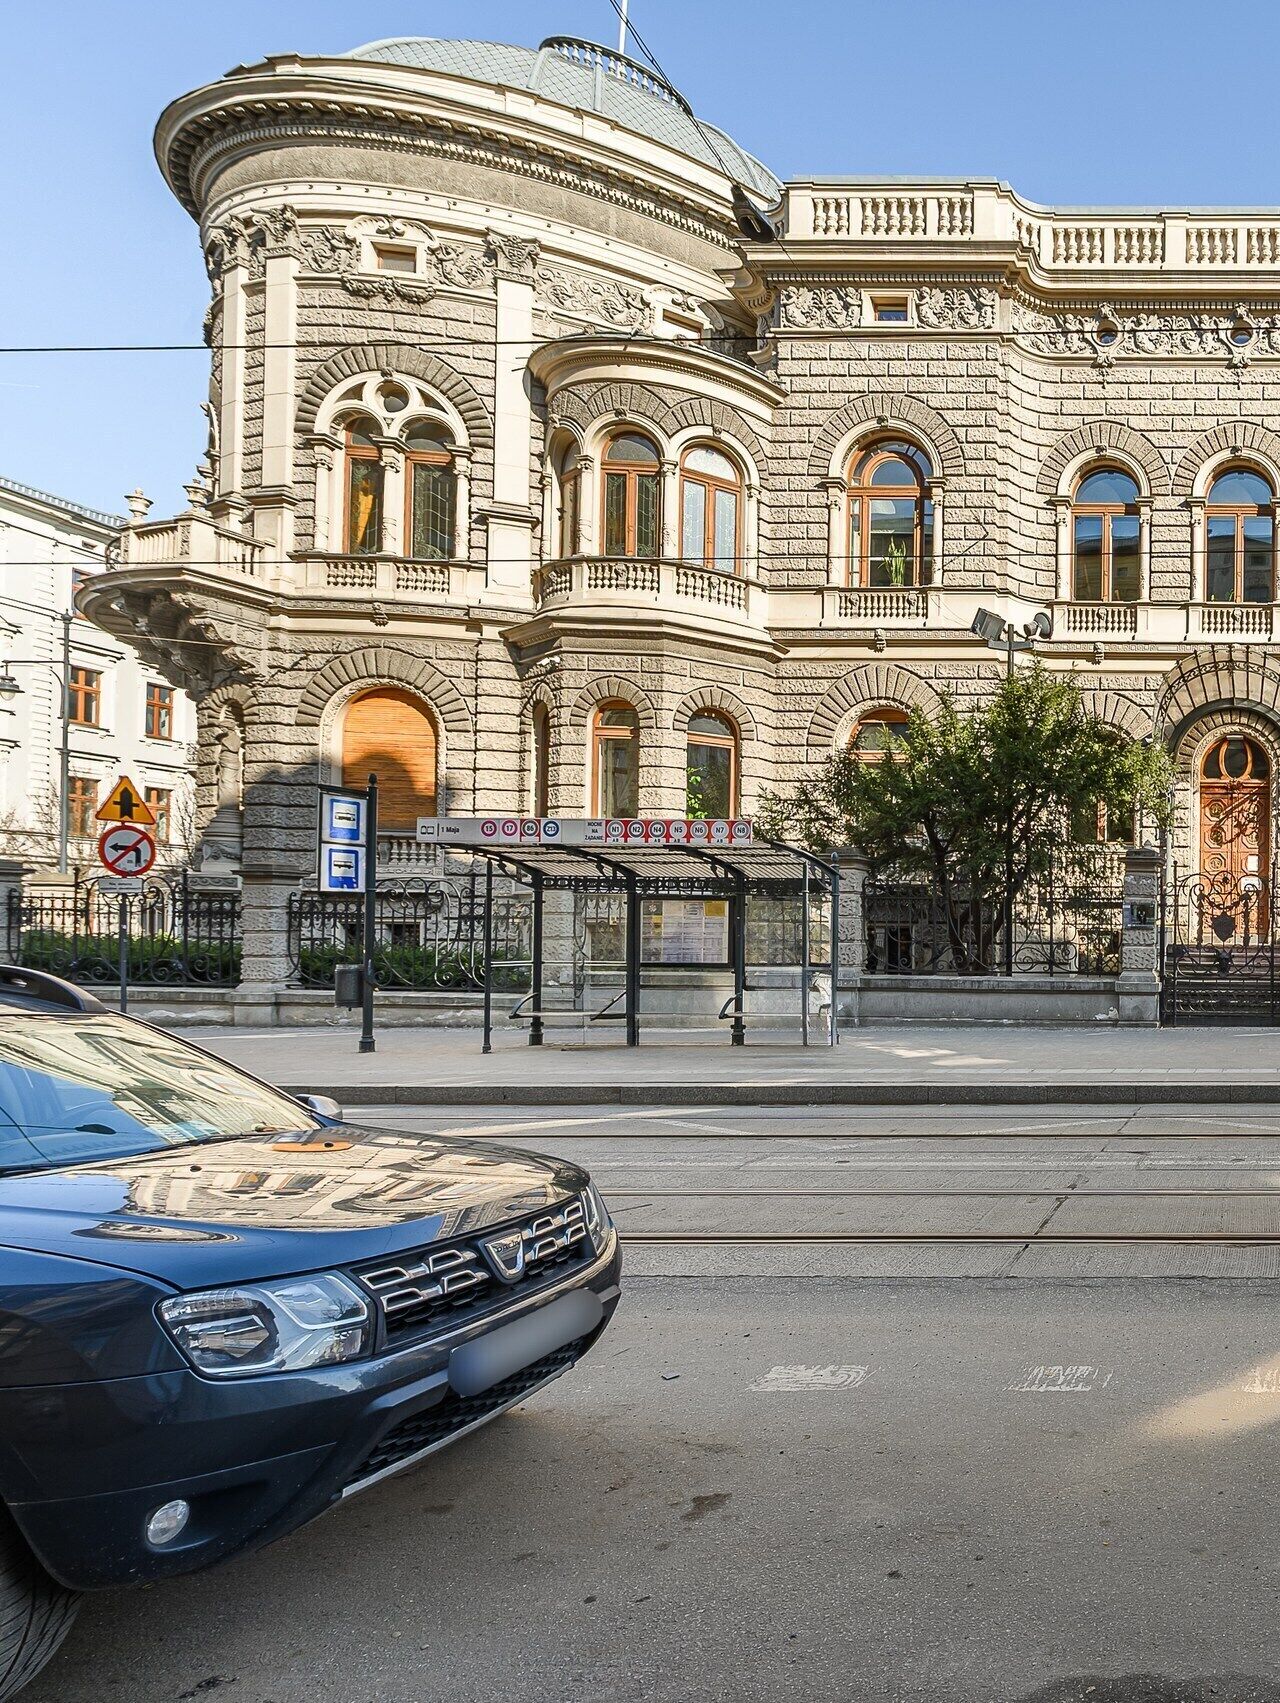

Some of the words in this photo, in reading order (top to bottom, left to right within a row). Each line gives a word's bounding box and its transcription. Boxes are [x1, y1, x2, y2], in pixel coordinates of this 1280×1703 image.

[446, 826, 460, 834] Maja
[694, 826, 704, 834] N6
[715, 826, 724, 834] N7
